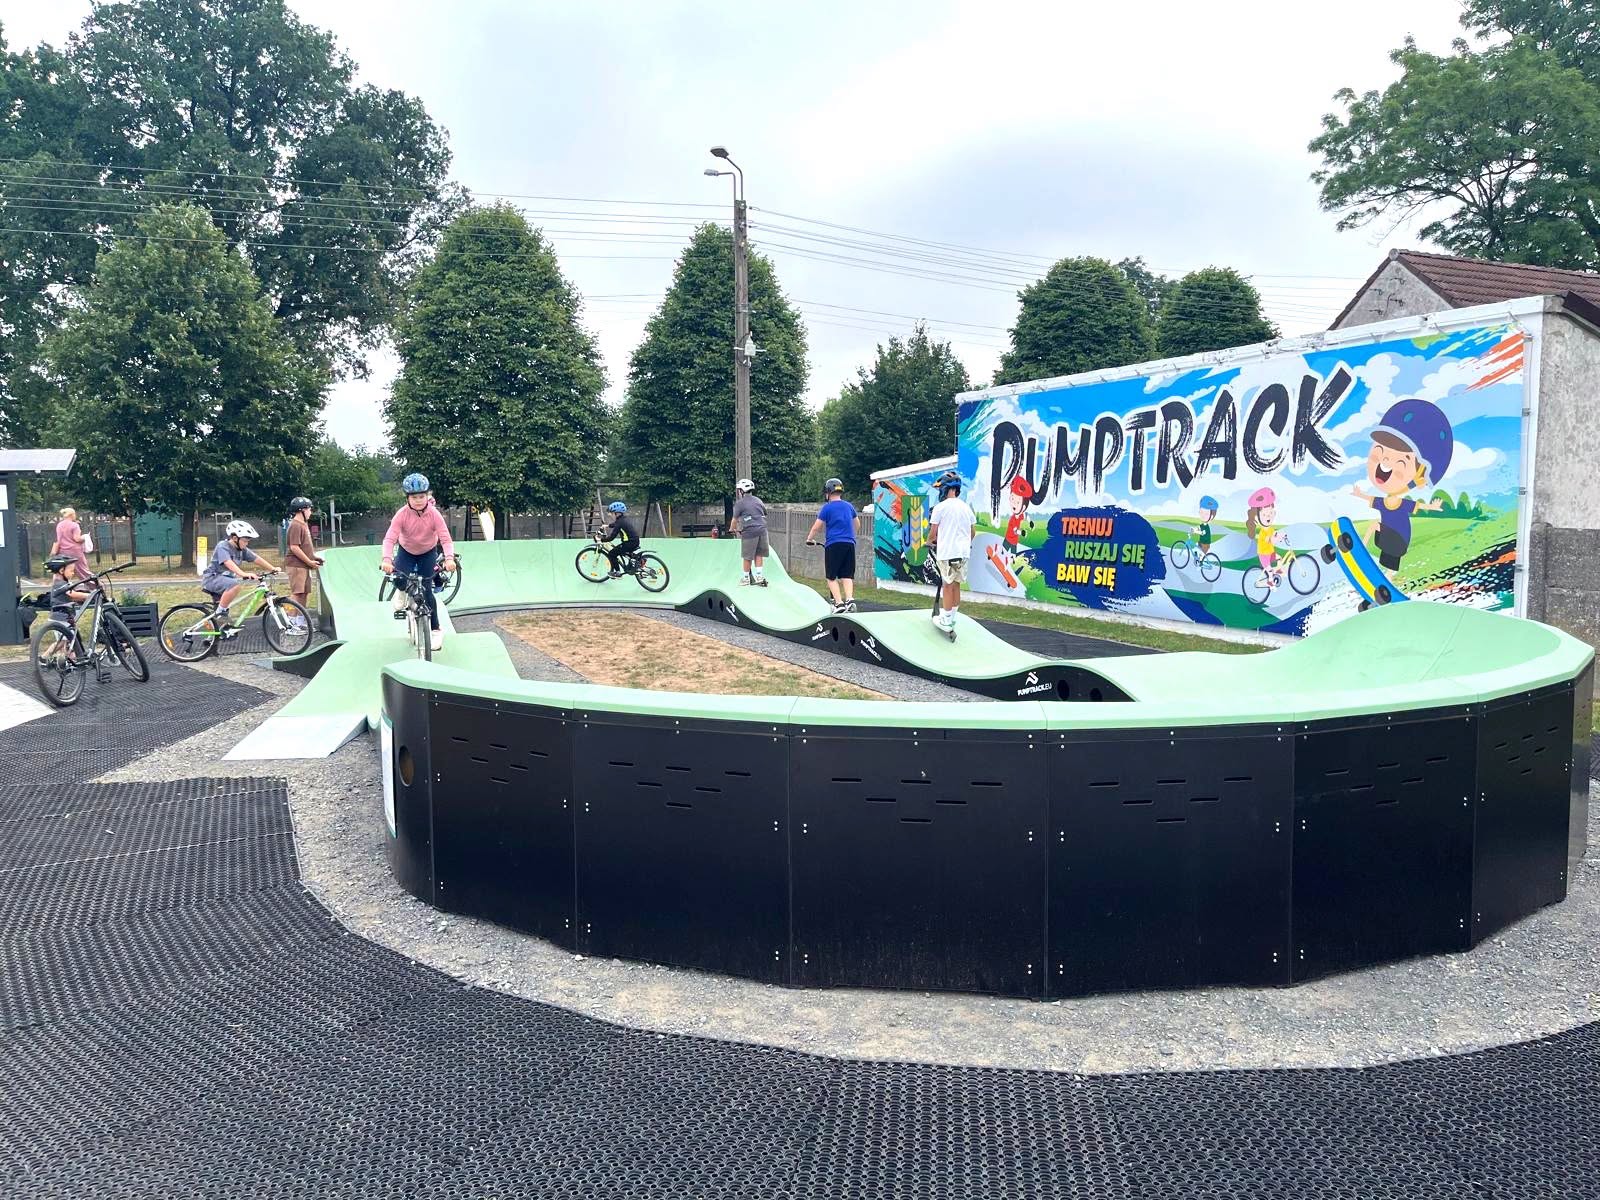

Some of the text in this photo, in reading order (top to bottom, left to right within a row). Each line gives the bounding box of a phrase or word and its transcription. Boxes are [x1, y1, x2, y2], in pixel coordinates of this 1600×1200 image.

[991, 367, 1352, 519] PUMPTRACK
[1062, 517, 1114, 536] TRENUJ
[1065, 541, 1145, 569] RUSZAJ SIĘ
[1057, 563, 1116, 591] BAW SIĘ
